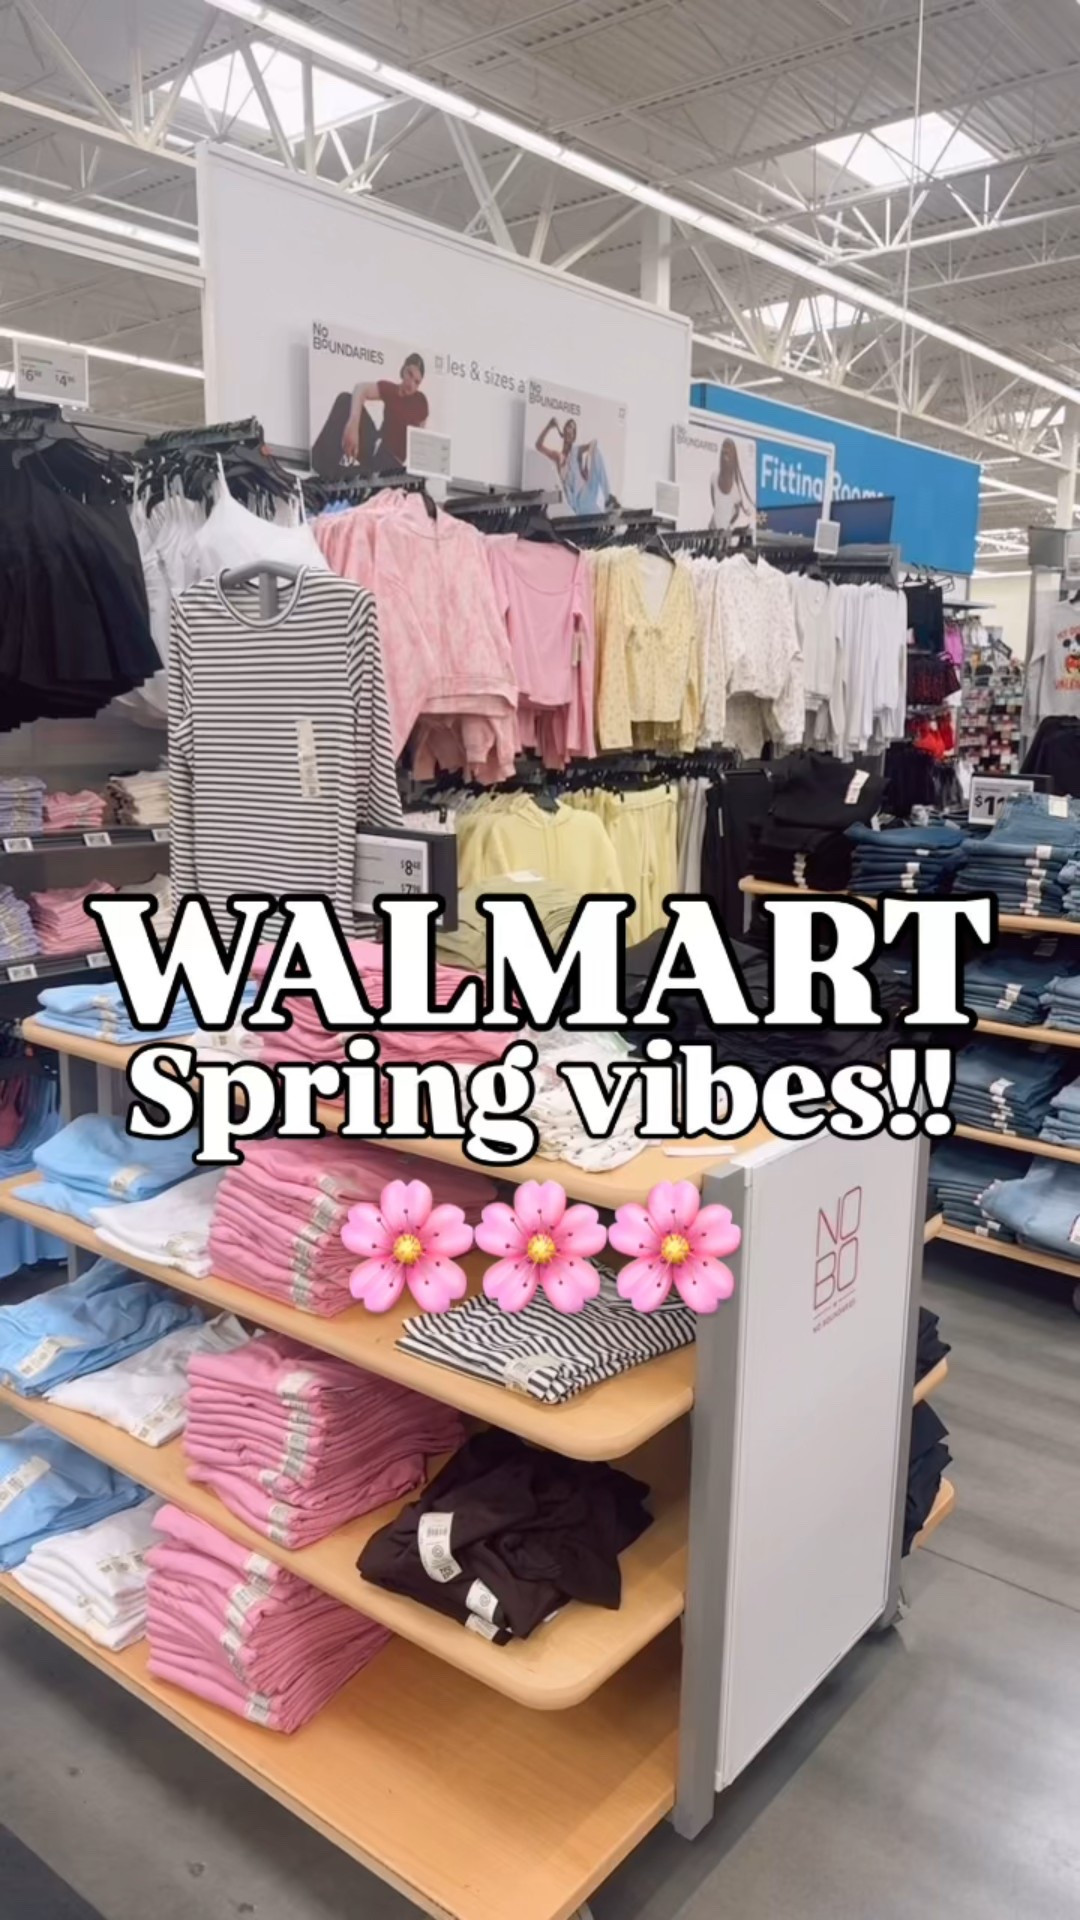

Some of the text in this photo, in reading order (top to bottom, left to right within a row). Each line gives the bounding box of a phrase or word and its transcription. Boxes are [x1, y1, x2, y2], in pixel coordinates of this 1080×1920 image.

[469, 360, 480, 382] &
[484, 366, 515, 392] sizes
[761, 453, 884, 503] Fitting Roo
[815, 1186, 862, 1257] NO
